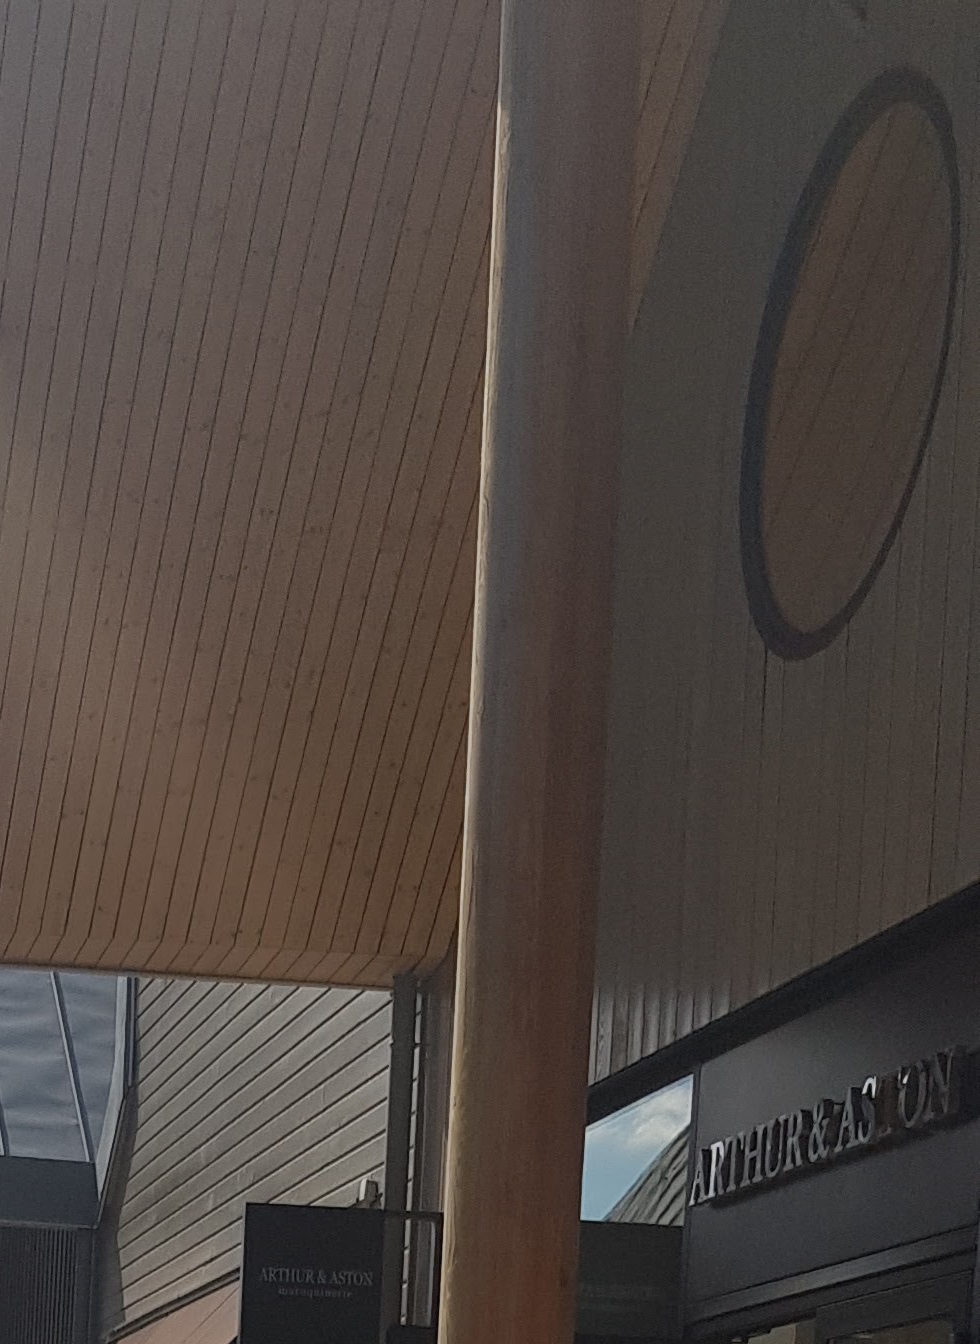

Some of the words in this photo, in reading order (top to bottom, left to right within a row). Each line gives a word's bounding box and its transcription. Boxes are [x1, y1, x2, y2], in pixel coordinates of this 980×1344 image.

[688, 1109, 804, 1206] ARTHUR
[807, 1099, 830, 1163] &
[259, 1267, 314, 1284] ARTHUR
[317, 1268, 326, 1284] &
[329, 1269, 373, 1286] ASTON
